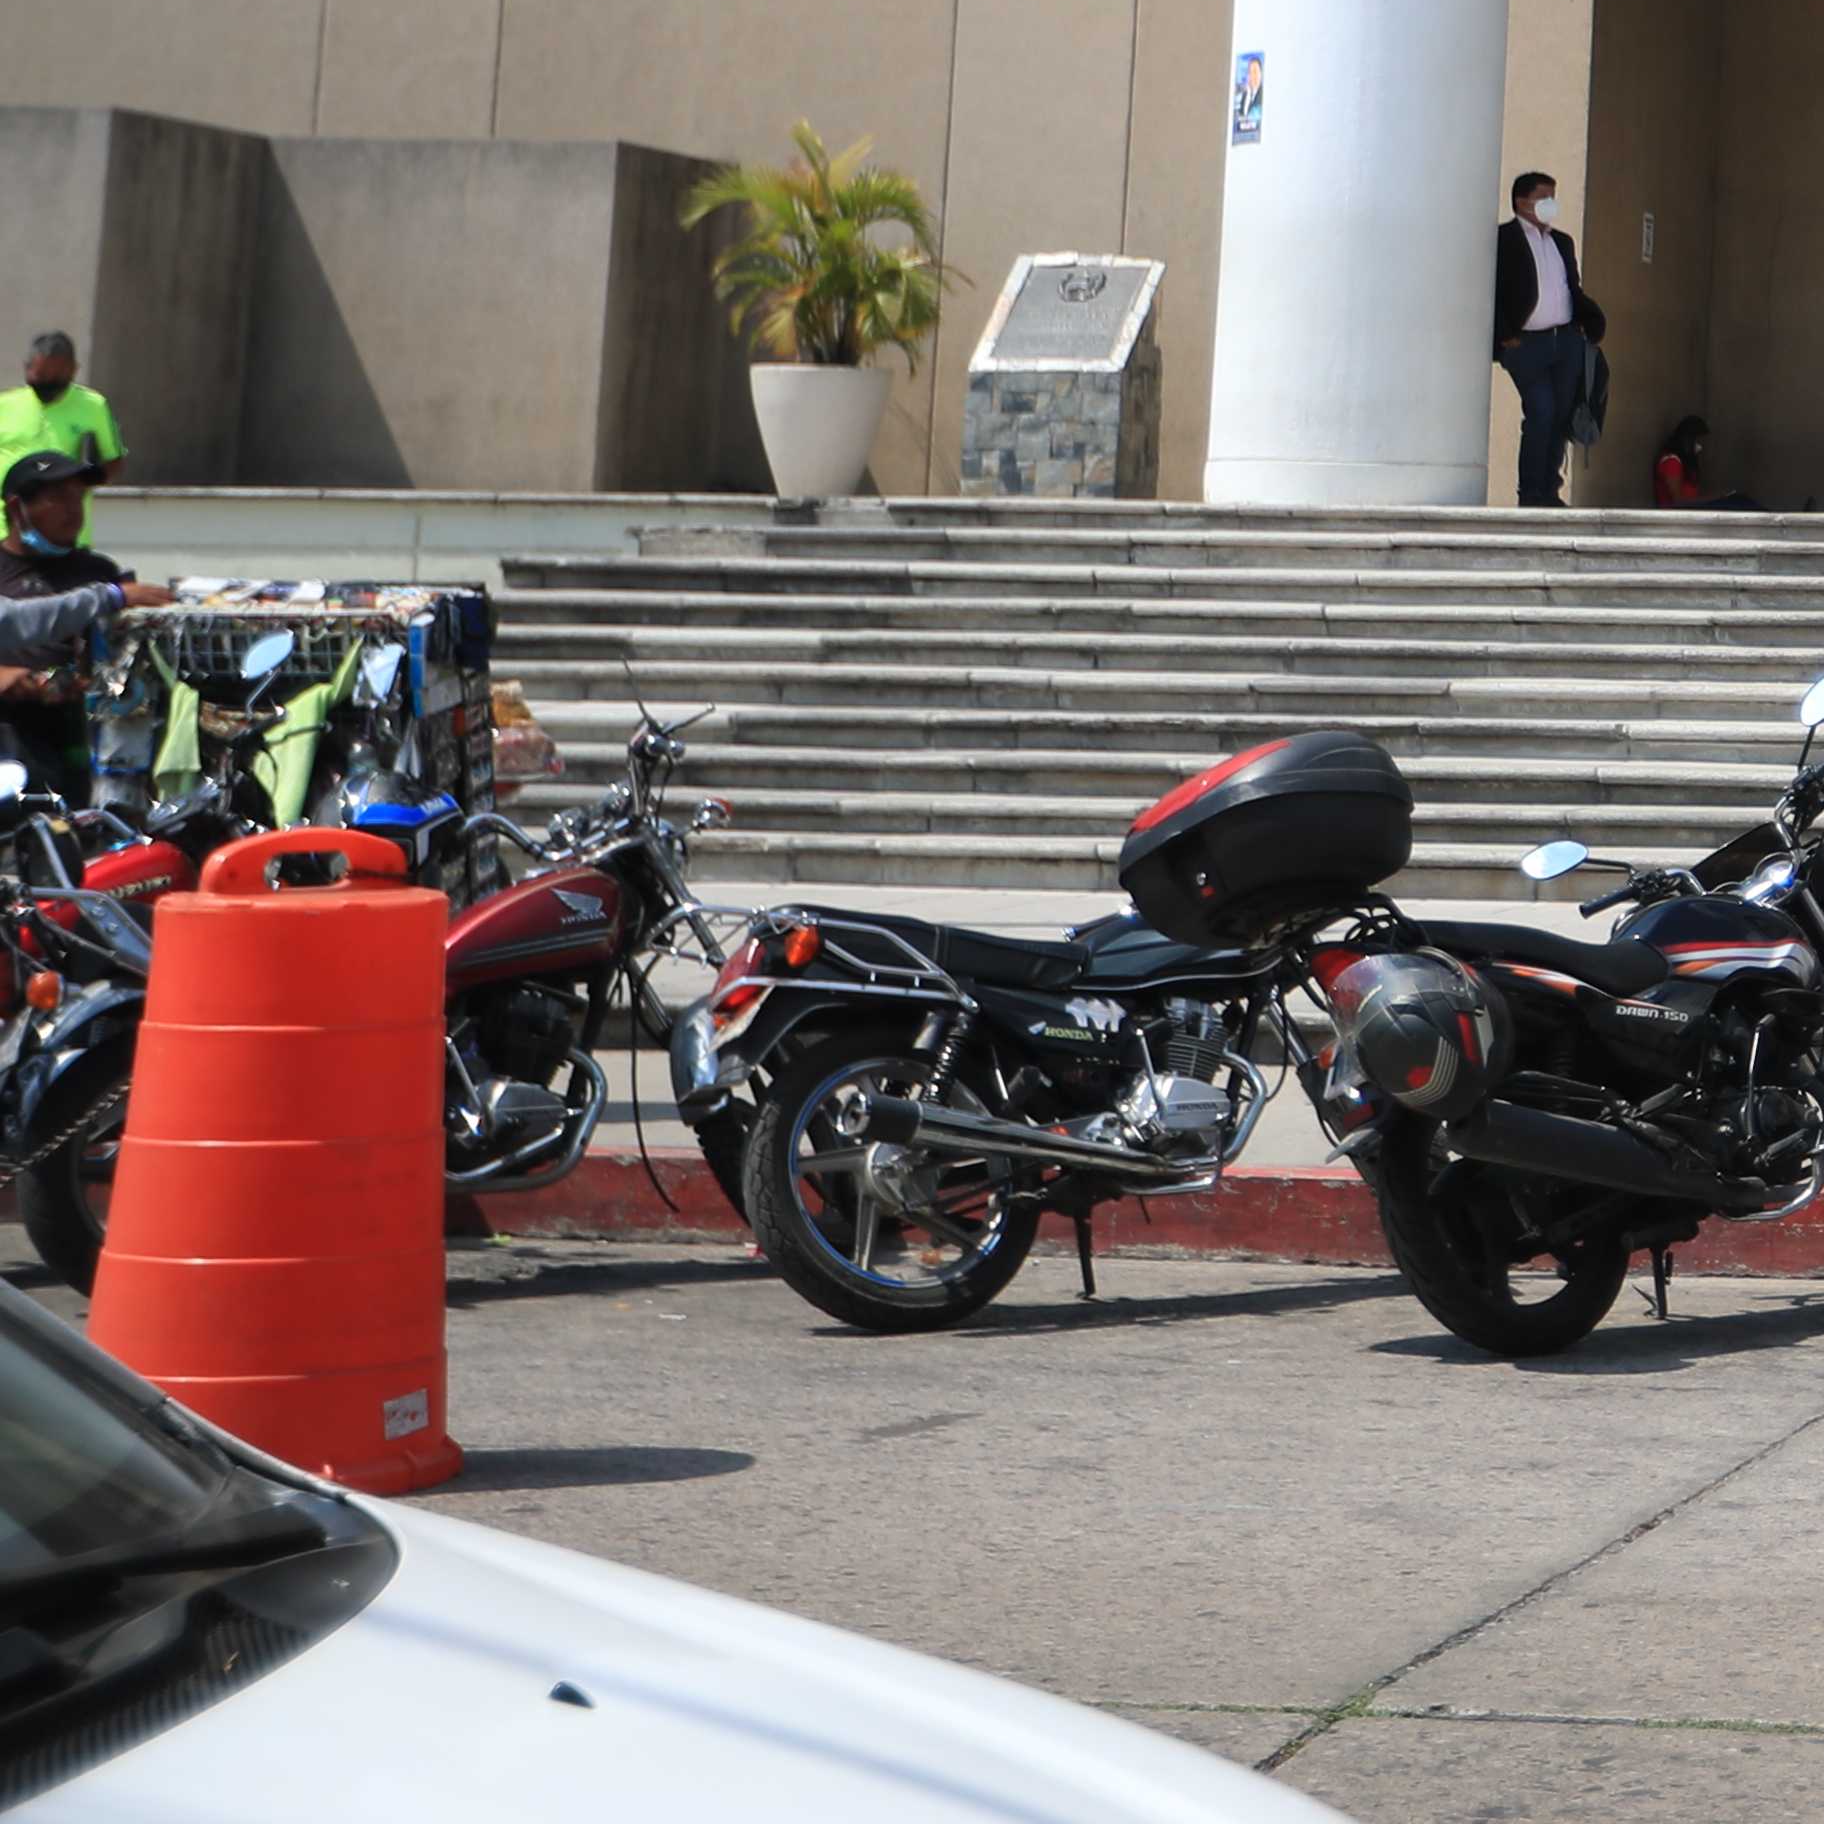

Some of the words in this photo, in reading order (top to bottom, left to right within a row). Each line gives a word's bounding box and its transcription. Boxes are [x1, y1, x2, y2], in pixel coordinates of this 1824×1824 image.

[106, 874, 172, 899] UZUKI
[1044, 1026, 1095, 1043] HONDA
[1176, 1100, 1219, 1111] HONDA
